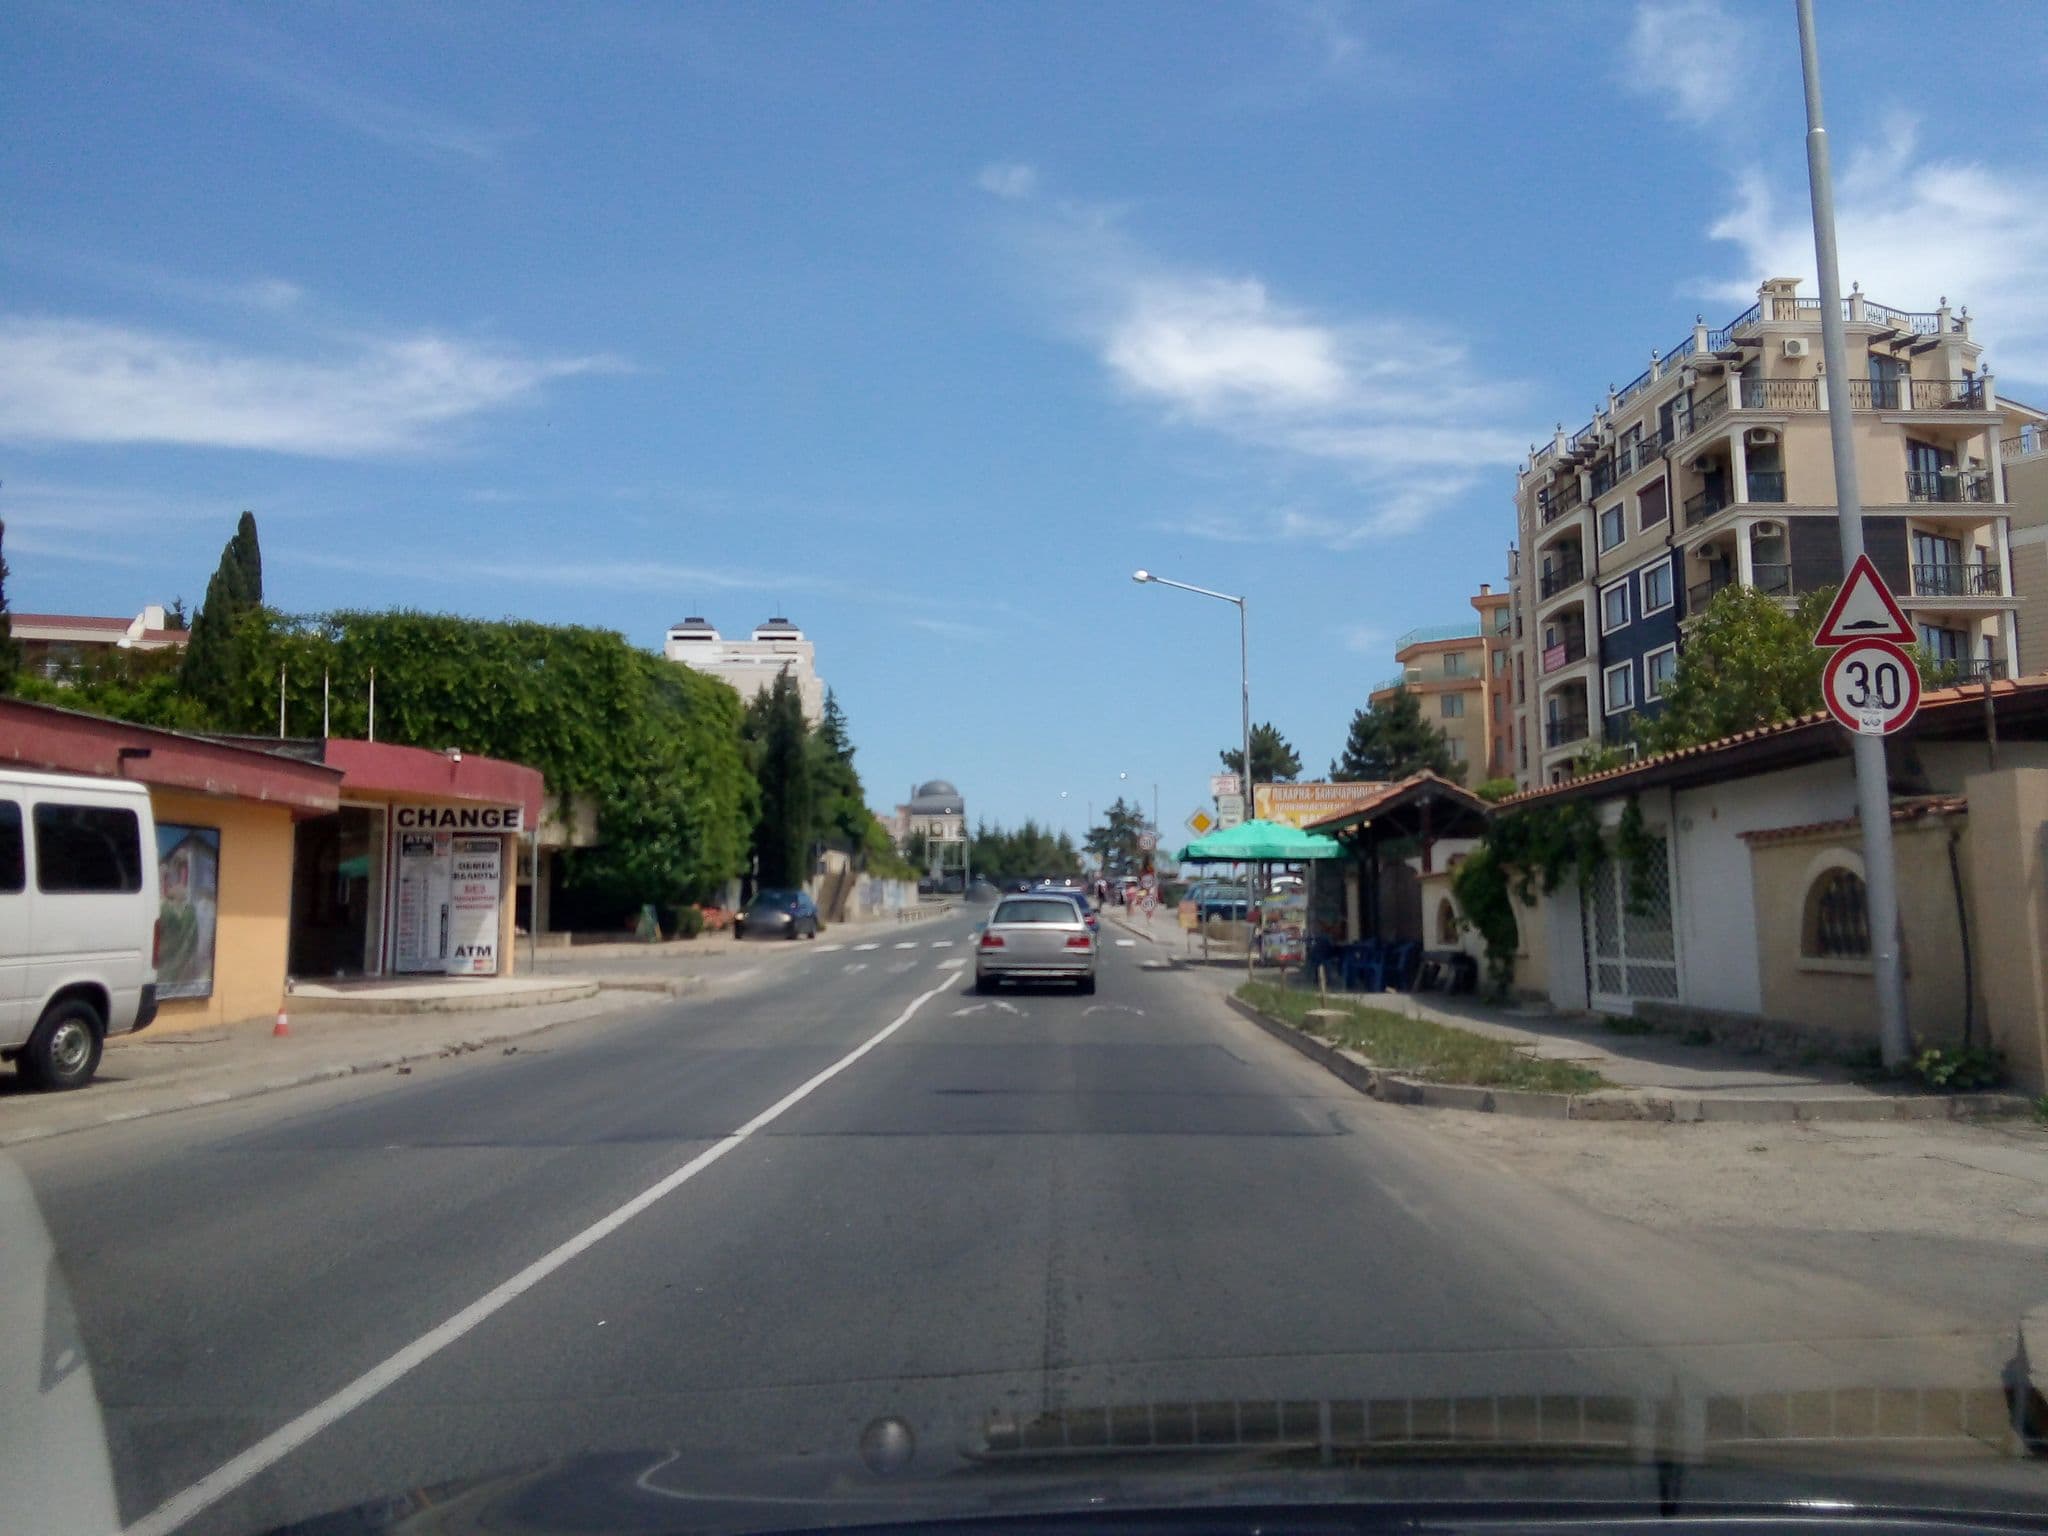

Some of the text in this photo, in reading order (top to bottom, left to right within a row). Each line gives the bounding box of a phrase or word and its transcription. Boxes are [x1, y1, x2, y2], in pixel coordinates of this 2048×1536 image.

[1846, 661, 1900, 709] 30
[398, 809, 519, 827] CHANGE
[455, 944, 492, 957] ATM
